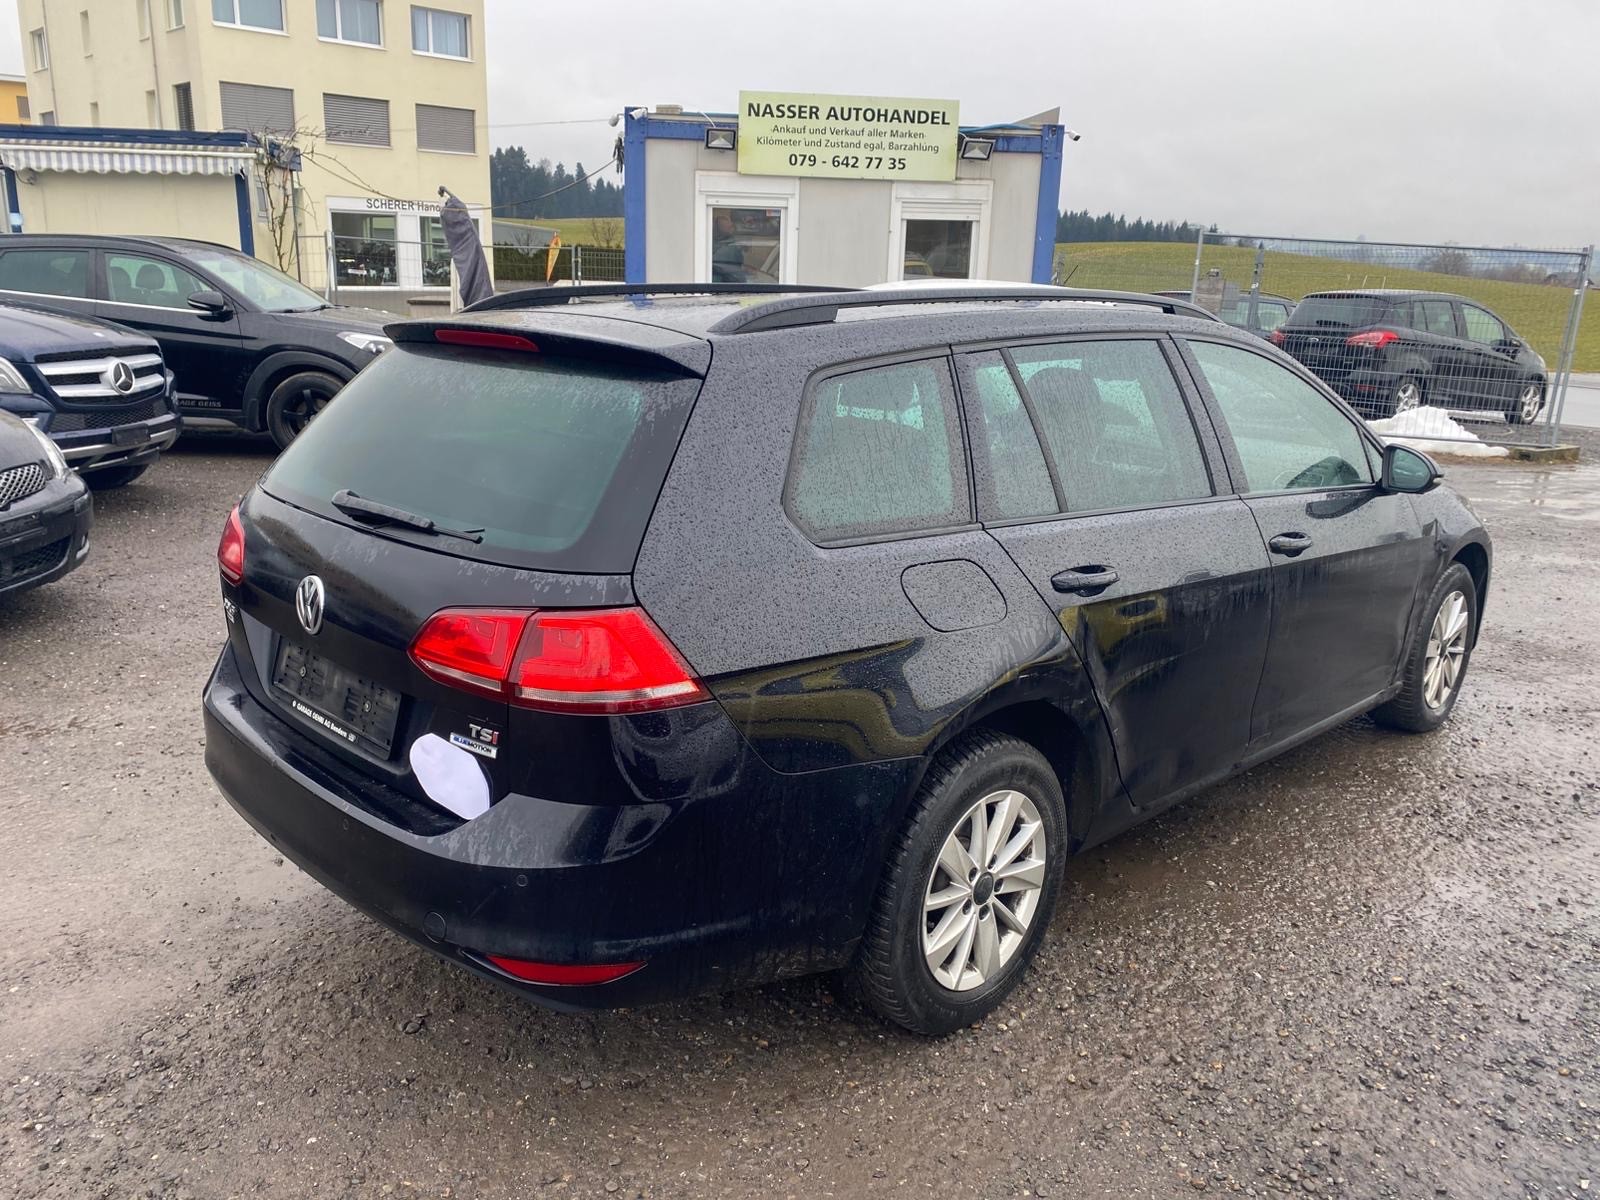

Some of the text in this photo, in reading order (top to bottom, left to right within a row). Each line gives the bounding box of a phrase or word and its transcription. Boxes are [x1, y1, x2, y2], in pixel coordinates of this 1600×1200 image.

[747, 102, 950, 125] NASSER AUTOHANDEL
[772, 124, 925, 139] Ankauf und Verkauf aller Marken
[756, 136, 802, 147] Kilometer
[804, 138, 822, 148] und
[824, 139, 861, 149] Zustand
[888, 141, 939, 153] Barzahlung
[788, 153, 817, 167] 079
[831, 155, 859, 168] 642
[865, 156, 883, 169] 77
[887, 157, 906, 170] 35
[366, 198, 415, 211] SCHERER
[452, 735, 492, 753] BLUEMOTION
